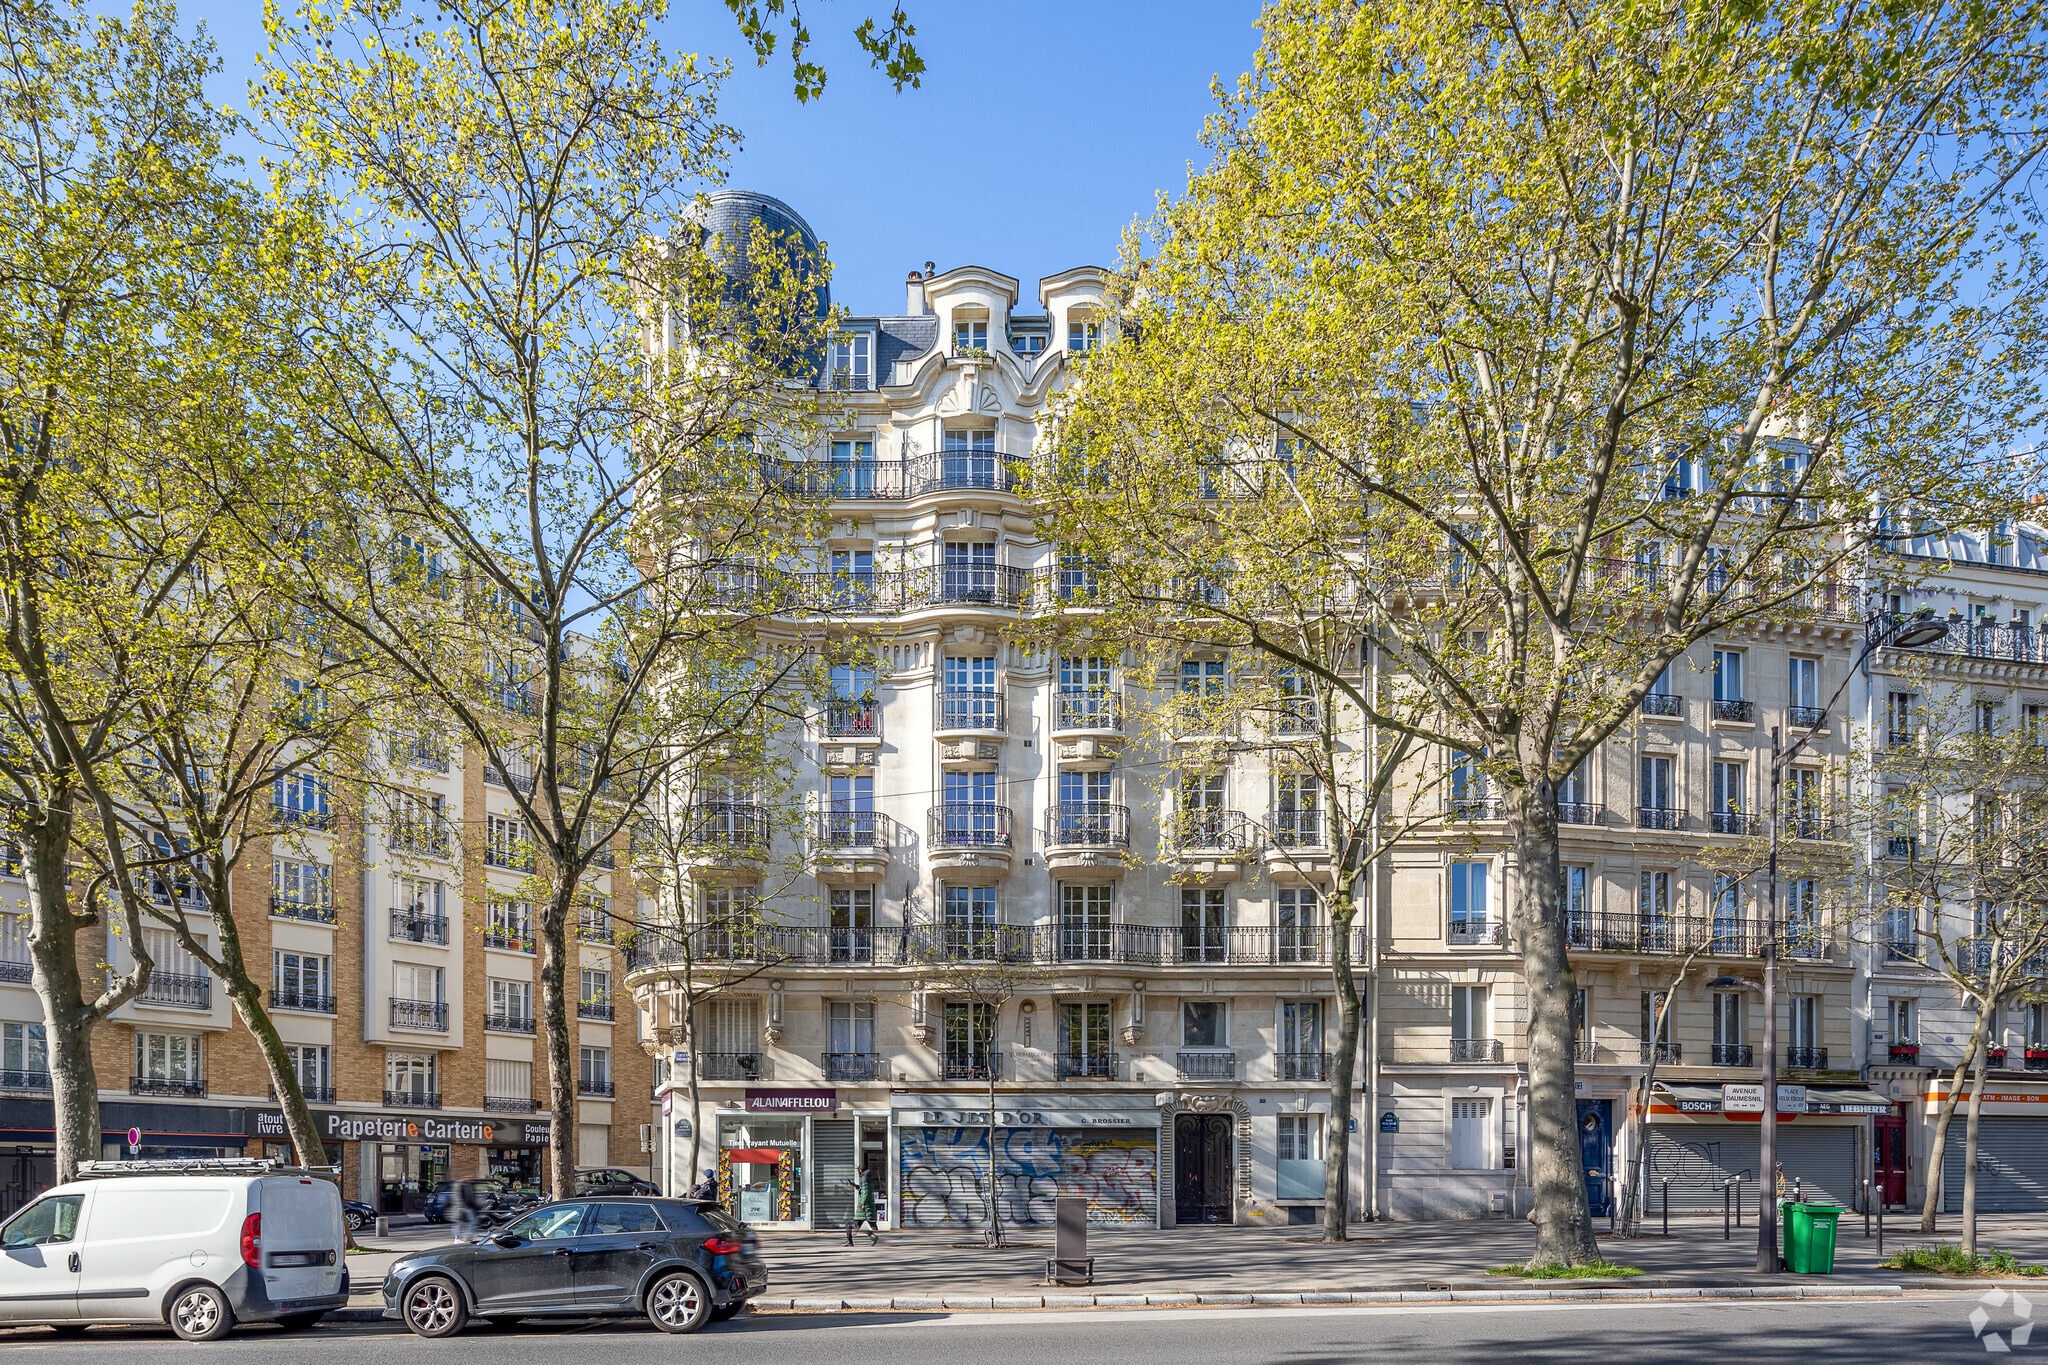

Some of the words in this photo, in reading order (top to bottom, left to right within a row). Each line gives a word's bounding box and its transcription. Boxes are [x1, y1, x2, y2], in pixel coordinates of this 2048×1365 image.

[751, 1098, 781, 1108] ALAIN
[780, 1098, 830, 1108] AFFLELOU
[1681, 1101, 1712, 1111] BOSCH
[1840, 1104, 1887, 1113] LIEBHERR
[257, 1113, 284, 1124] atout
[922, 1112, 945, 1124] LE
[952, 1112, 990, 1124] JET
[257, 1122, 284, 1134] livre
[328, 1115, 419, 1139] Papeterie
[424, 1119, 494, 1140] Carterie
[525, 1124, 550, 1133] Couleu
[525, 1134, 550, 1143] Papie
[728, 1139, 744, 1147] Ties
[769, 1139, 798, 1147] Mutuelle
